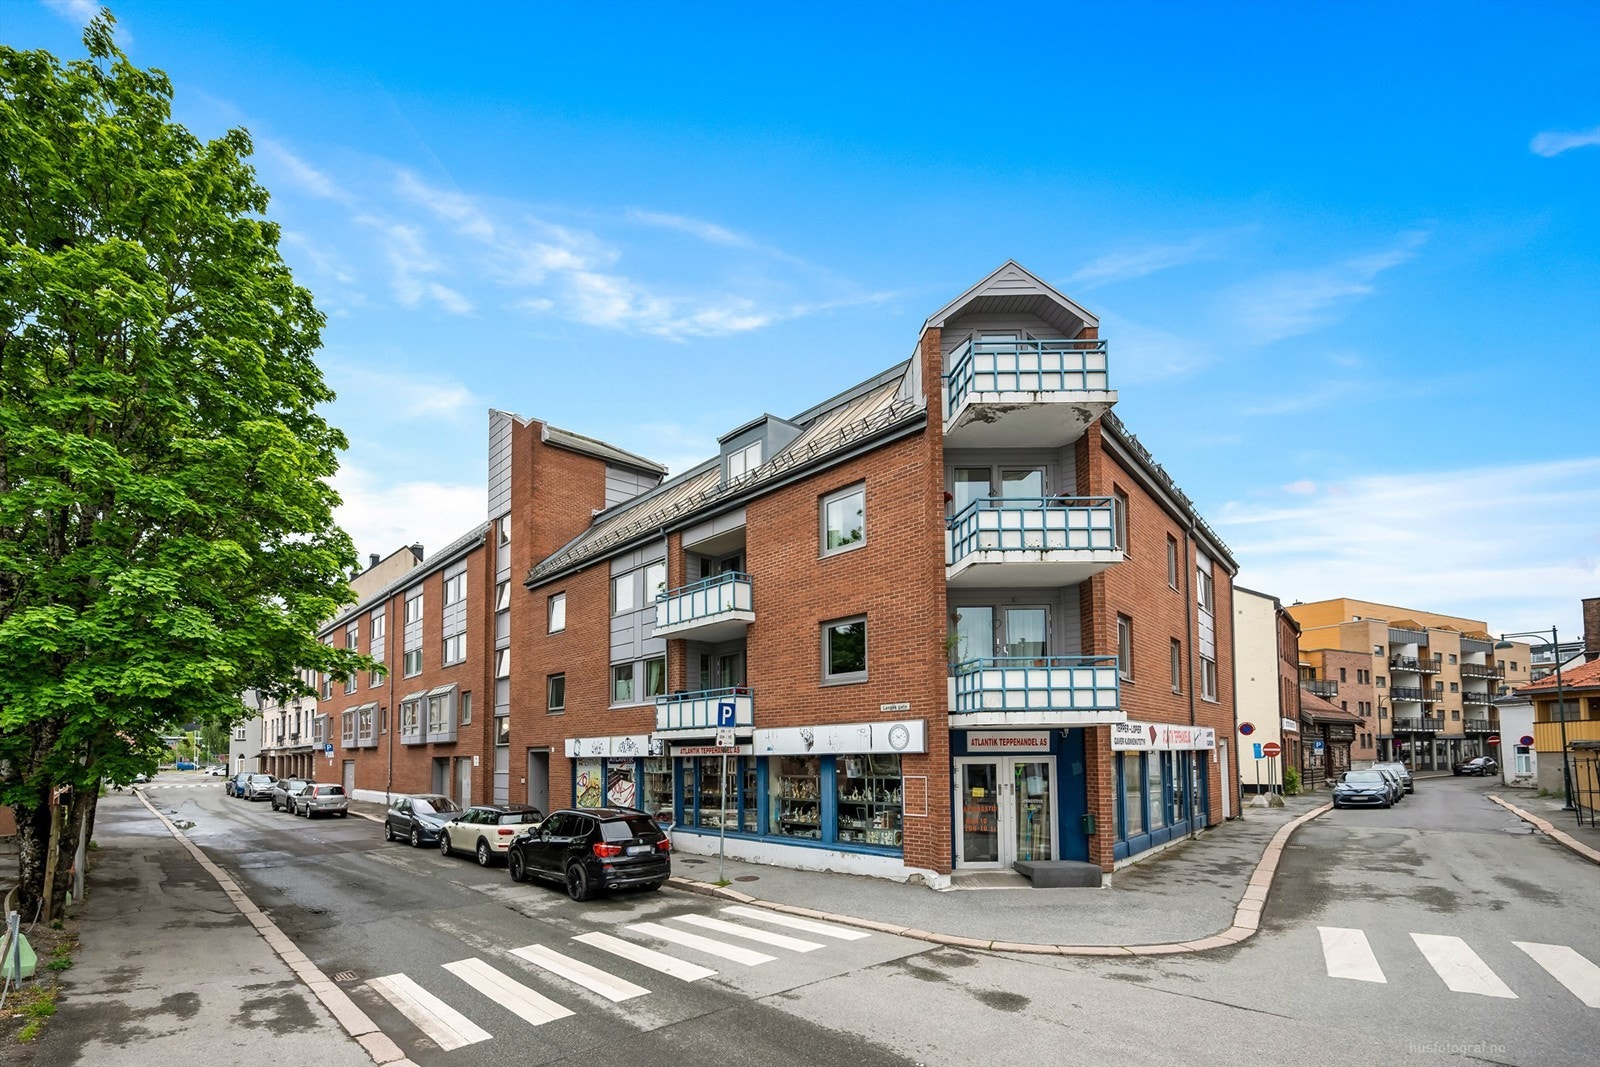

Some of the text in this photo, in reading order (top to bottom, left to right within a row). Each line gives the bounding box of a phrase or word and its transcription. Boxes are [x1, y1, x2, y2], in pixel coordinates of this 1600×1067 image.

[722, 706, 733, 725] P
[999, 737, 1038, 747] TEPPEHANDEL
[1040, 737, 1047, 746] AS
[680, 746, 740, 755] ATLANTIK TEPPEHANEL AS
